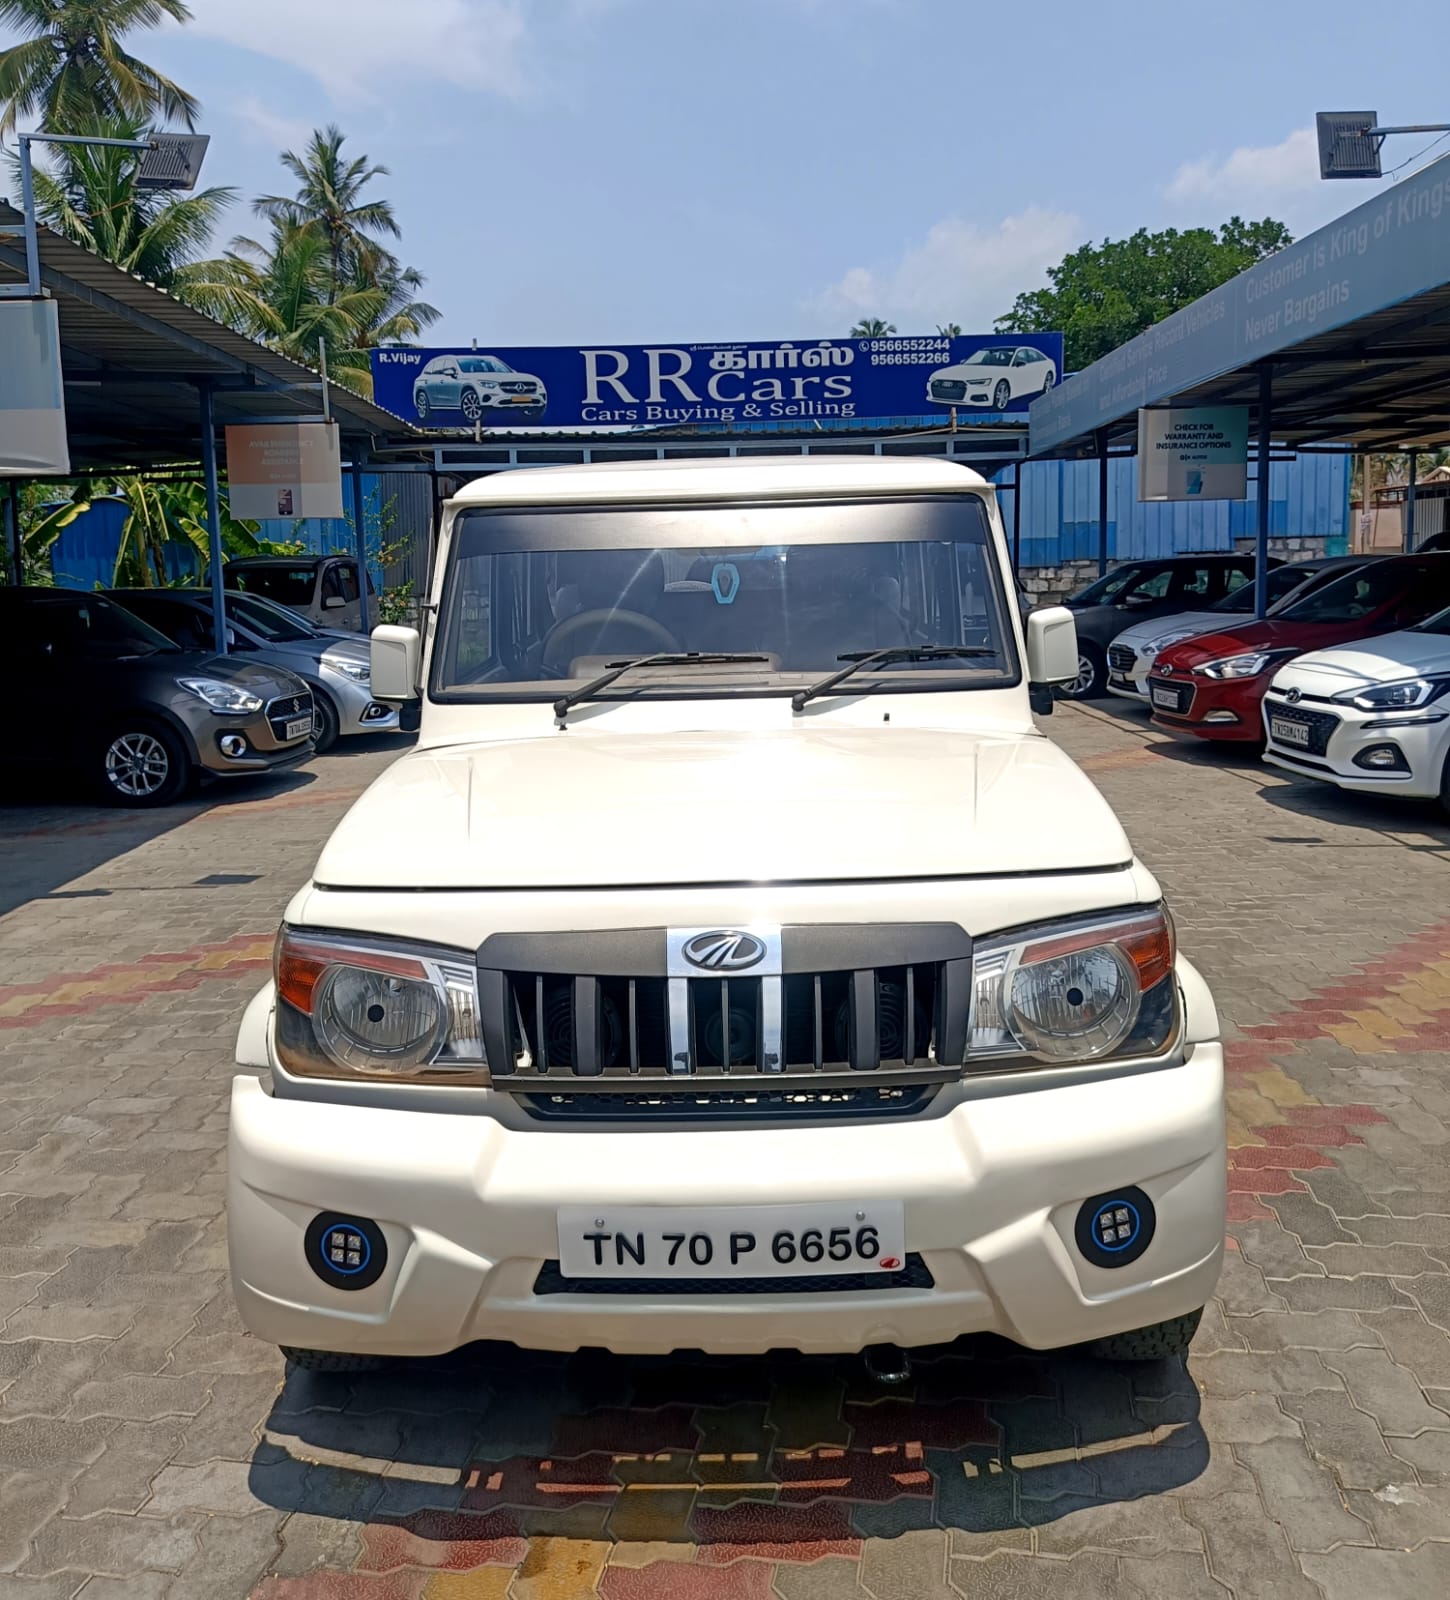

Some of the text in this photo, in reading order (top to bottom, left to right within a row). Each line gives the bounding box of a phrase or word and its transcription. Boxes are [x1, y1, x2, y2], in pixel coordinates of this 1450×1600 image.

[1246, 252, 1310, 304] Customer
[1330, 222, 1369, 262] King
[1374, 202, 1393, 238] of
[1245, 280, 1350, 344] Never Bargains
[870, 338, 950, 352] 9566552244
[379, 352, 421, 365] R.Vijay
[871, 352, 950, 365] 9566552266
[707, 370, 852, 402] Cars
[581, 400, 856, 423] Cars Buying & Selling
[1174, 423, 1198, 431] CHECK
[1164, 432, 1224, 440] WARRANTY AND
[1199, 441, 1232, 449] OPTIONS
[583, 1226, 880, 1266] TN 70 P 6656
